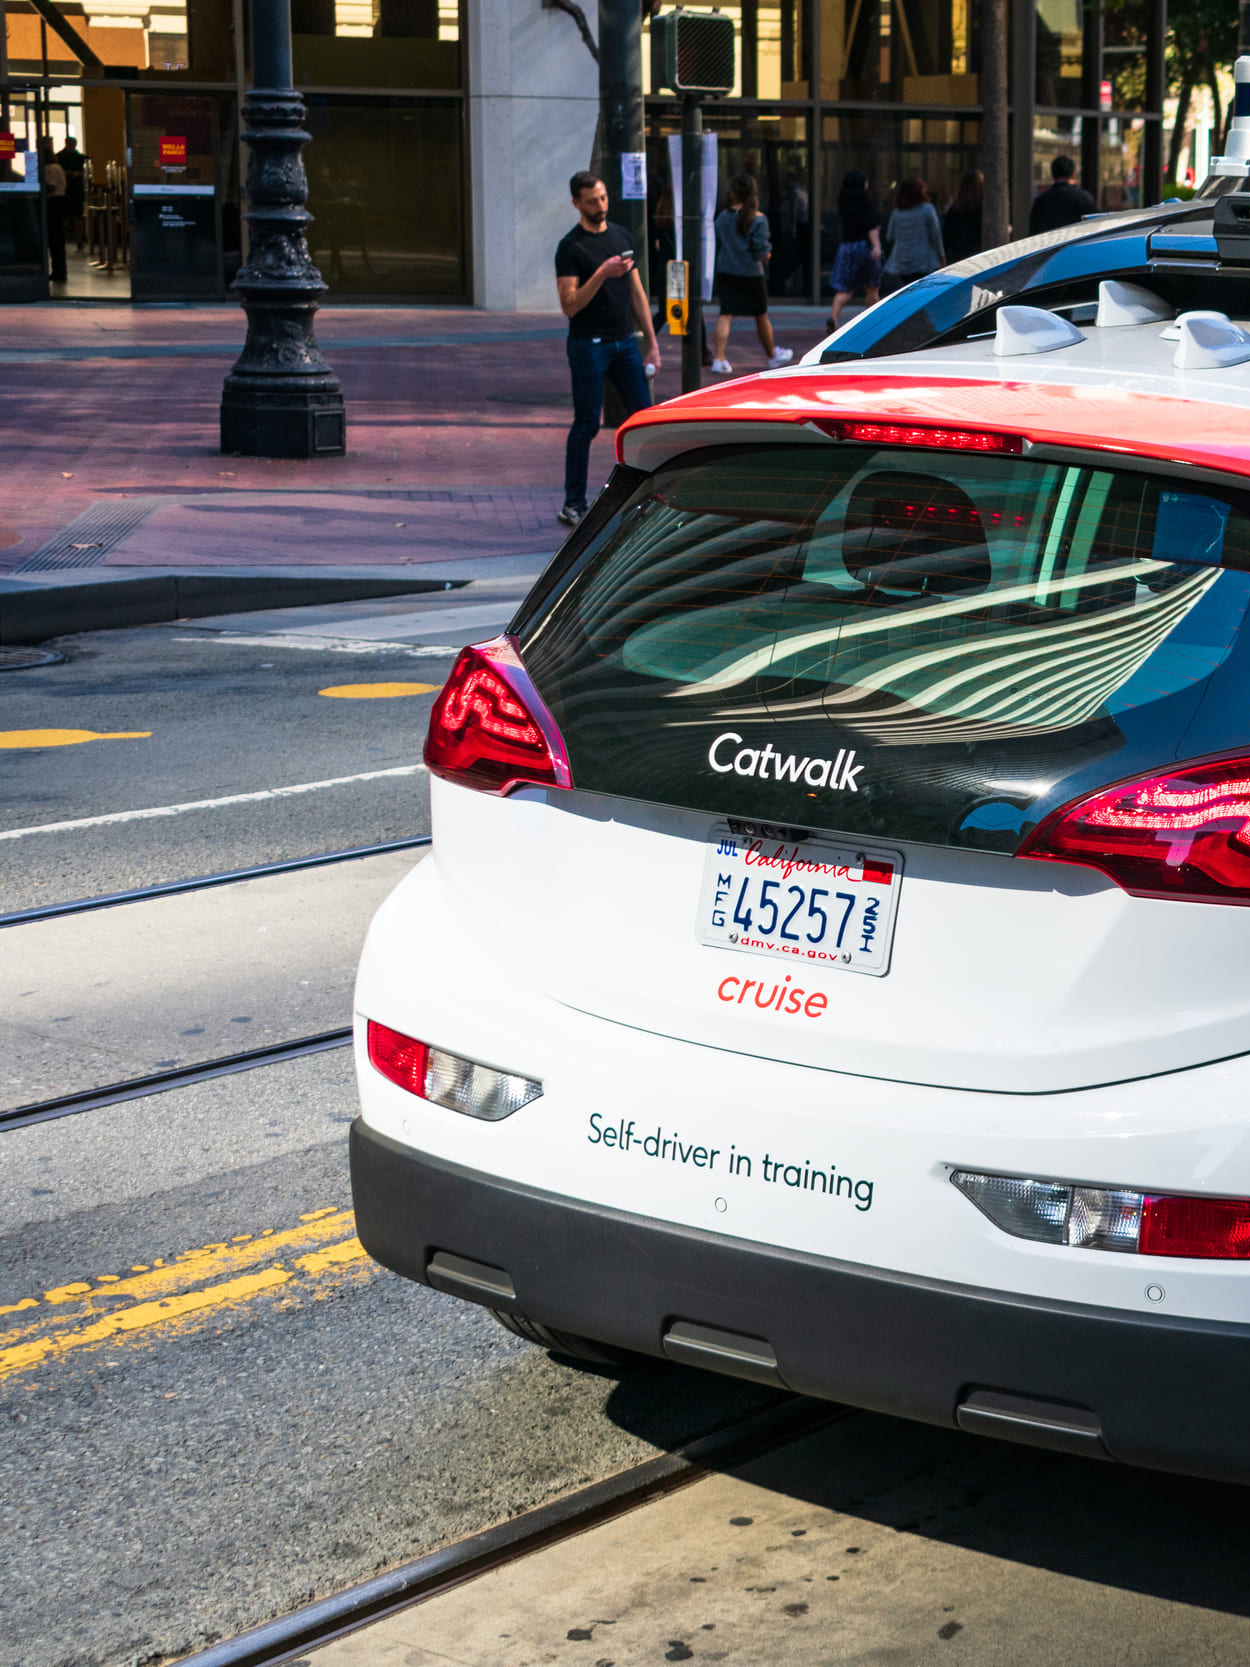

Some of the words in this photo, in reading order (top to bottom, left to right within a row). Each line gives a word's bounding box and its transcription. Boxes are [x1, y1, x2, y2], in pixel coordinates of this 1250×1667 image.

[708, 732, 865, 792] Catwalk
[717, 839, 738, 857] JUL
[745, 839, 862, 882] California
[733, 876, 856, 948] 45257
[740, 937, 838, 961] dmv.ca.gov
[717, 974, 829, 1018] cruise
[587, 1112, 720, 1169] Self-driver
[728, 1144, 752, 1177] in
[761, 1153, 875, 1212] training
